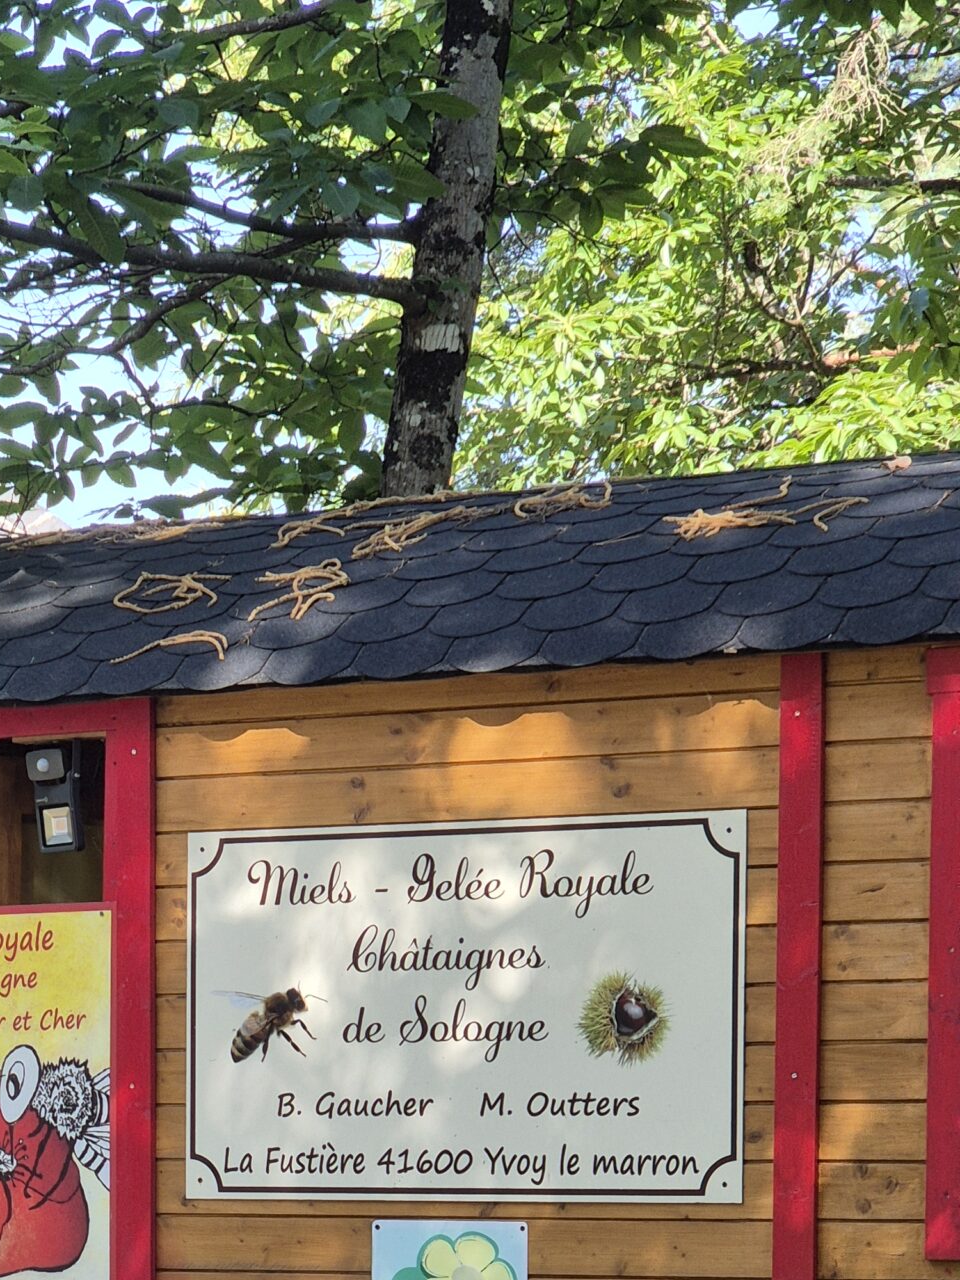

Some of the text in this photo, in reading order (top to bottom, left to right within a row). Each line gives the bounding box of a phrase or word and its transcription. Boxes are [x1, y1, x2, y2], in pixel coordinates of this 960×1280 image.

[247, 859, 356, 906] Miels
[407, 853, 505, 904] Gelée
[519, 848, 655, 919] Royale
[346, 924, 546, 991] Châtaignes
[12, 1011, 32, 1031] et
[39, 1008, 87, 1030] Cher
[342, 994, 550, 1063] de Sologne
[277, 1090, 640, 1118] B. Gaucher M. Outters
[224, 1142, 700, 1184] La Fustière 41600 Yvoy le marron
